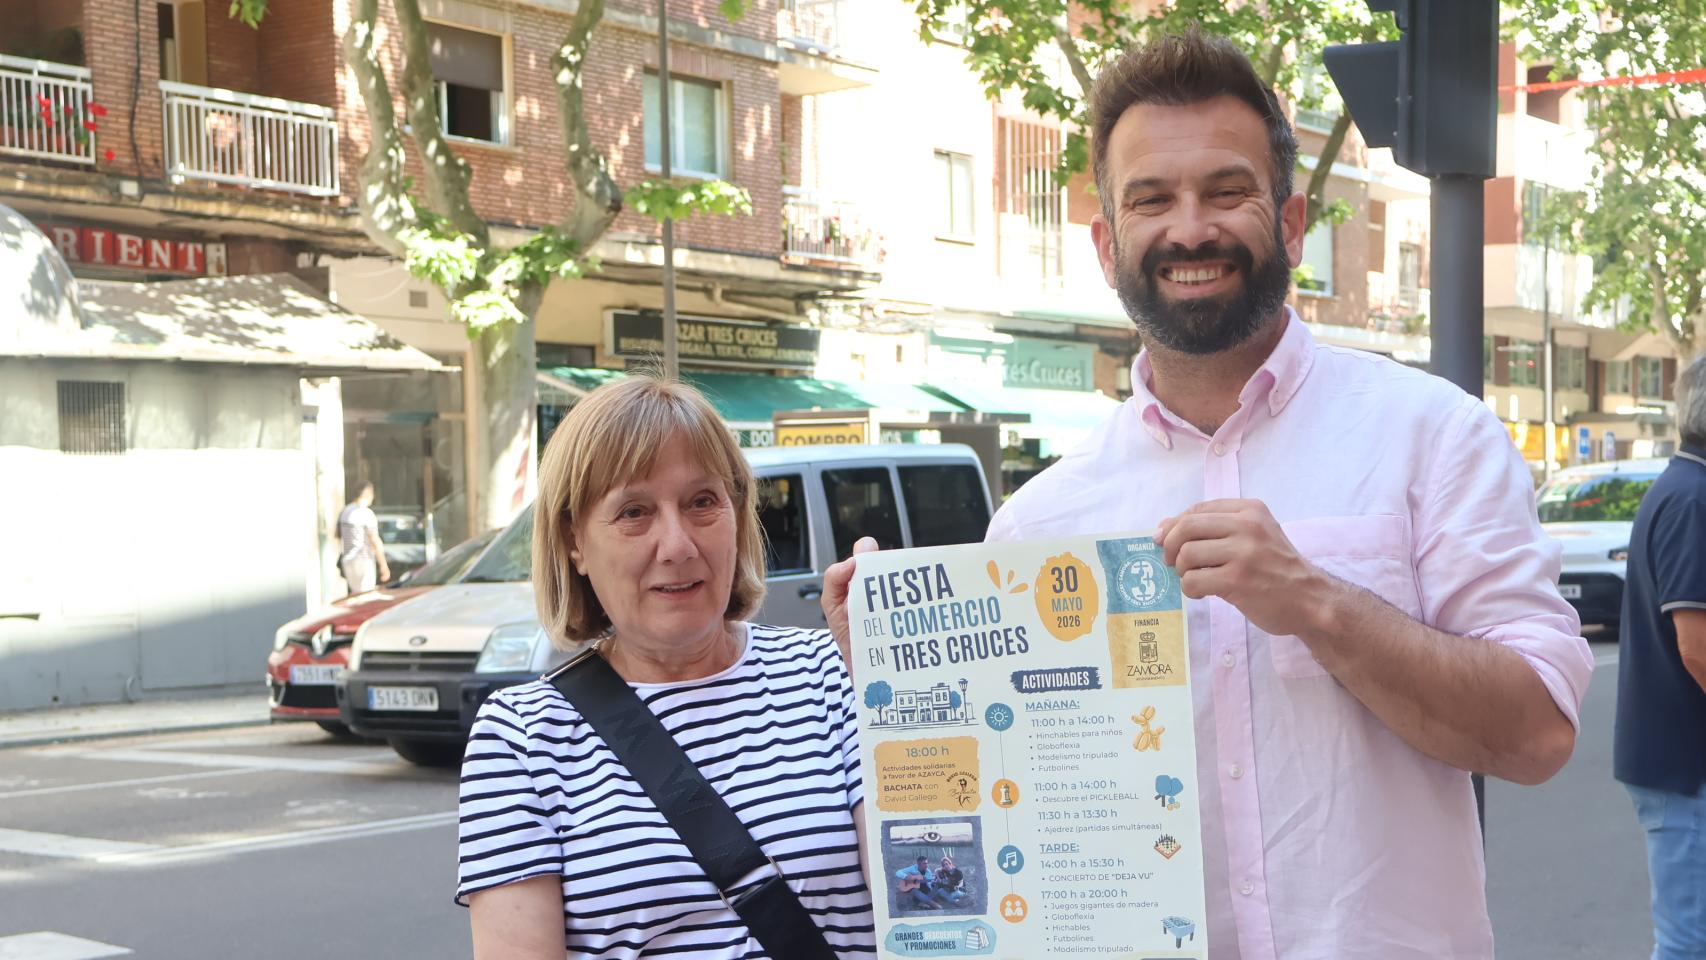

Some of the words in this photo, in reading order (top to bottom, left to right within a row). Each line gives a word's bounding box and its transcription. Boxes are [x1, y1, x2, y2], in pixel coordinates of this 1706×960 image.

[52, 226, 203, 272] RIENT
[675, 322, 705, 342] AZAR
[707, 325, 733, 344] TRES
[736, 328, 778, 347] CRUCES
[1030, 359, 1082, 386] Cruces
[1127, 542, 1155, 552] ORGANIZA
[1050, 565, 1078, 593] 30
[1130, 560, 1156, 602] 3
[863, 563, 955, 613] FIESTA
[1051, 596, 1083, 612] MAYO
[863, 616, 886, 638] DEL
[890, 596, 1002, 639] COMERCIO
[1056, 614, 1081, 628] 2026
[1134, 618, 1160, 627] FINANCIA
[868, 646, 886, 667] EN
[889, 639, 942, 672] TRES
[945, 625, 1029, 664] CRUCES
[1127, 663, 1174, 677] ZAMORA
[1022, 671, 1090, 690] ACTIVIDADES
[1025, 699, 1080, 711] MAÑANA:
[1031, 717, 1056, 728] 11:00
[1058, 716, 1066, 726] h
[1078, 715, 1105, 726] 14:00
[1107, 715, 1115, 724] h
[1036, 730, 1080, 739] Hinchables
[1081, 730, 1100, 740] para
[1101, 728, 1123, 736] niños
[905, 746, 938, 758] 18:00
[941, 745, 949, 755] h
[1036, 742, 1080, 751] Globoflexia
[1038, 753, 1081, 761] Modelismo
[1082, 751, 1119, 760] tripulado
[882, 764, 922, 772] Actividades
[1038, 763, 1080, 772] Futbolines
[884, 783, 922, 792] BACHATA
[1034, 782, 1058, 791] 11:00
[1061, 781, 1068, 791] h
[1079, 780, 1107, 789] 14:00
[1110, 779, 1117, 788] h
[884, 795, 907, 803] David
[908, 794, 938, 802] Gallego
[1042, 795, 1079, 803] Descubre
[1089, 793, 1139, 801] PICKLEBALL
[1038, 811, 1061, 820] 11:30
[1064, 810, 1071, 819] h
[1082, 809, 1108, 819] 13:30
[1110, 809, 1118, 818] h
[1044, 826, 1074, 835] Ajedrez
[1075, 824, 1110, 834] (partidas
[1040, 843, 1080, 853] TARDE:
[1040, 860, 1068, 869] 14:00
[1071, 859, 1078, 868] h
[1089, 858, 1115, 868] 15:30
[1117, 858, 1125, 867] h
[1048, 874, 1097, 882] CONCIERTO
[1098, 873, 1110, 881] DE
[1041, 890, 1067, 899] 17:00
[1070, 889, 1077, 899] h
[1088, 889, 1118, 898] 20:00
[1120, 888, 1128, 897] h
[1050, 902, 1079, 911] Juegos
[1080, 902, 1114, 911] gigantes
[1128, 900, 1159, 908] madera
[1051, 912, 1095, 921] Globoflexia
[1052, 924, 1091, 932] Hichables
[895, 931, 924, 942] GRANDES
[910, 940, 956, 951] PROMOCIONES
[1053, 945, 1096, 953] Modelismo
[1097, 945, 1134, 954] tripulado
